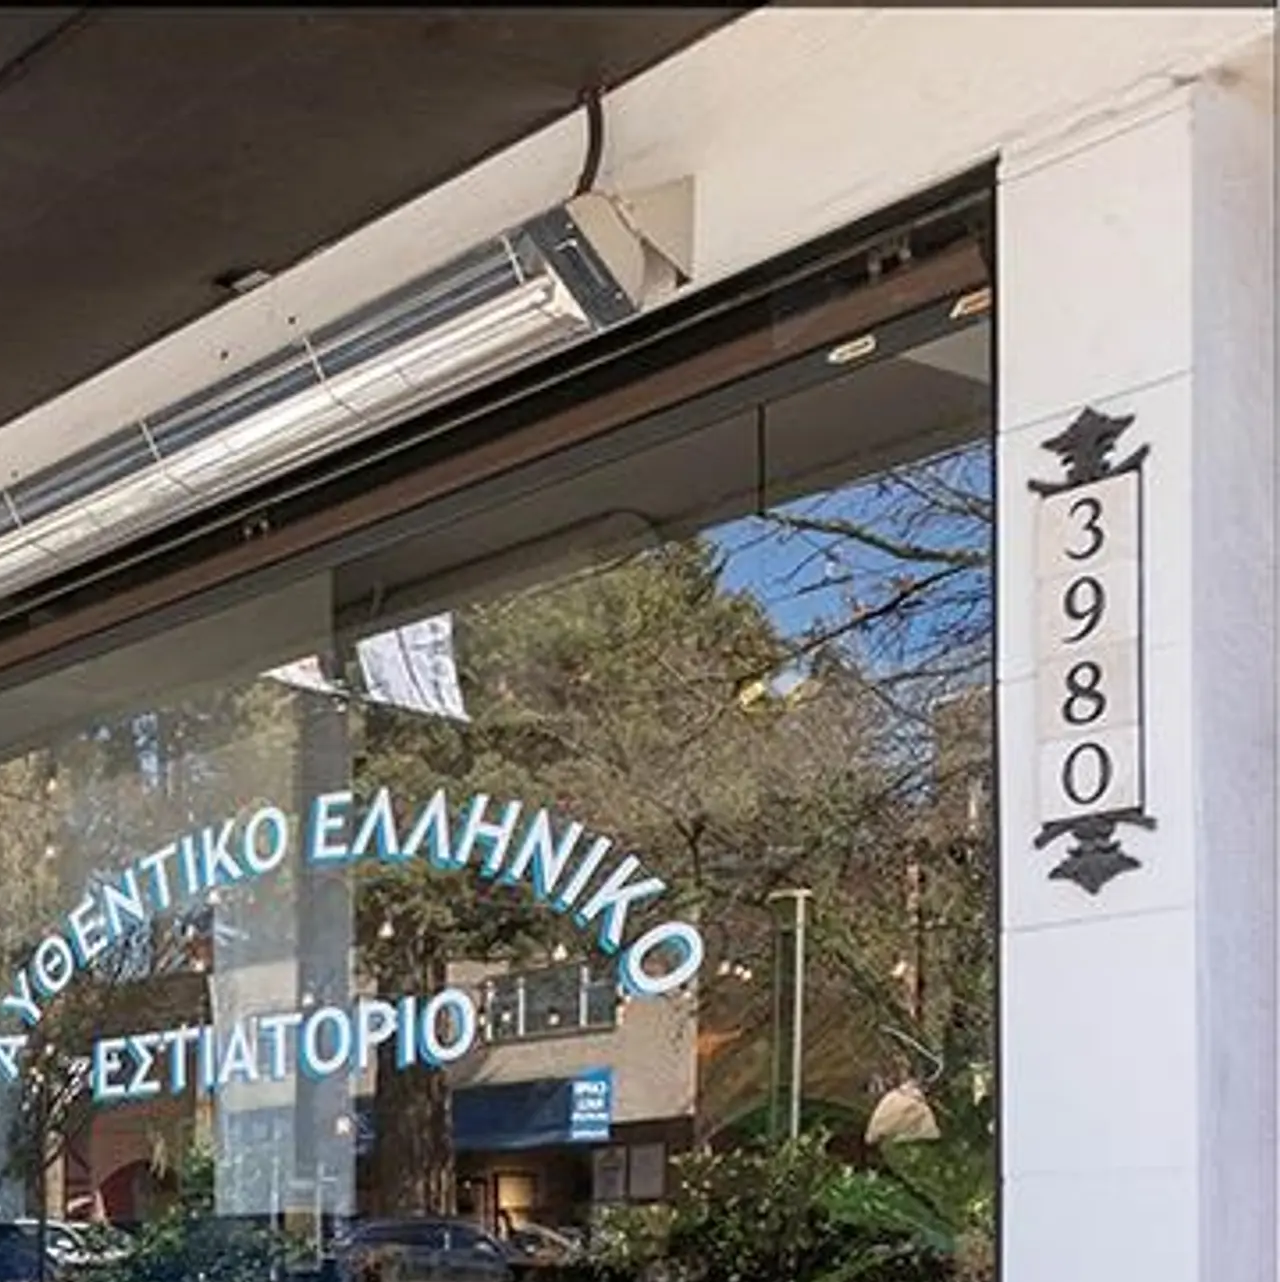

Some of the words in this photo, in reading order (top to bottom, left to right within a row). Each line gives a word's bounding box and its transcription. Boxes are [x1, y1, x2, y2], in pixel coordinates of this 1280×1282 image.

[1061, 497, 1113, 805] 3980
[310, 786, 704, 997] ΕΛΛΗΝΙΚΟ
[92, 988, 476, 1098] ΕΣΤΙΑΤΟΡΙΟ
